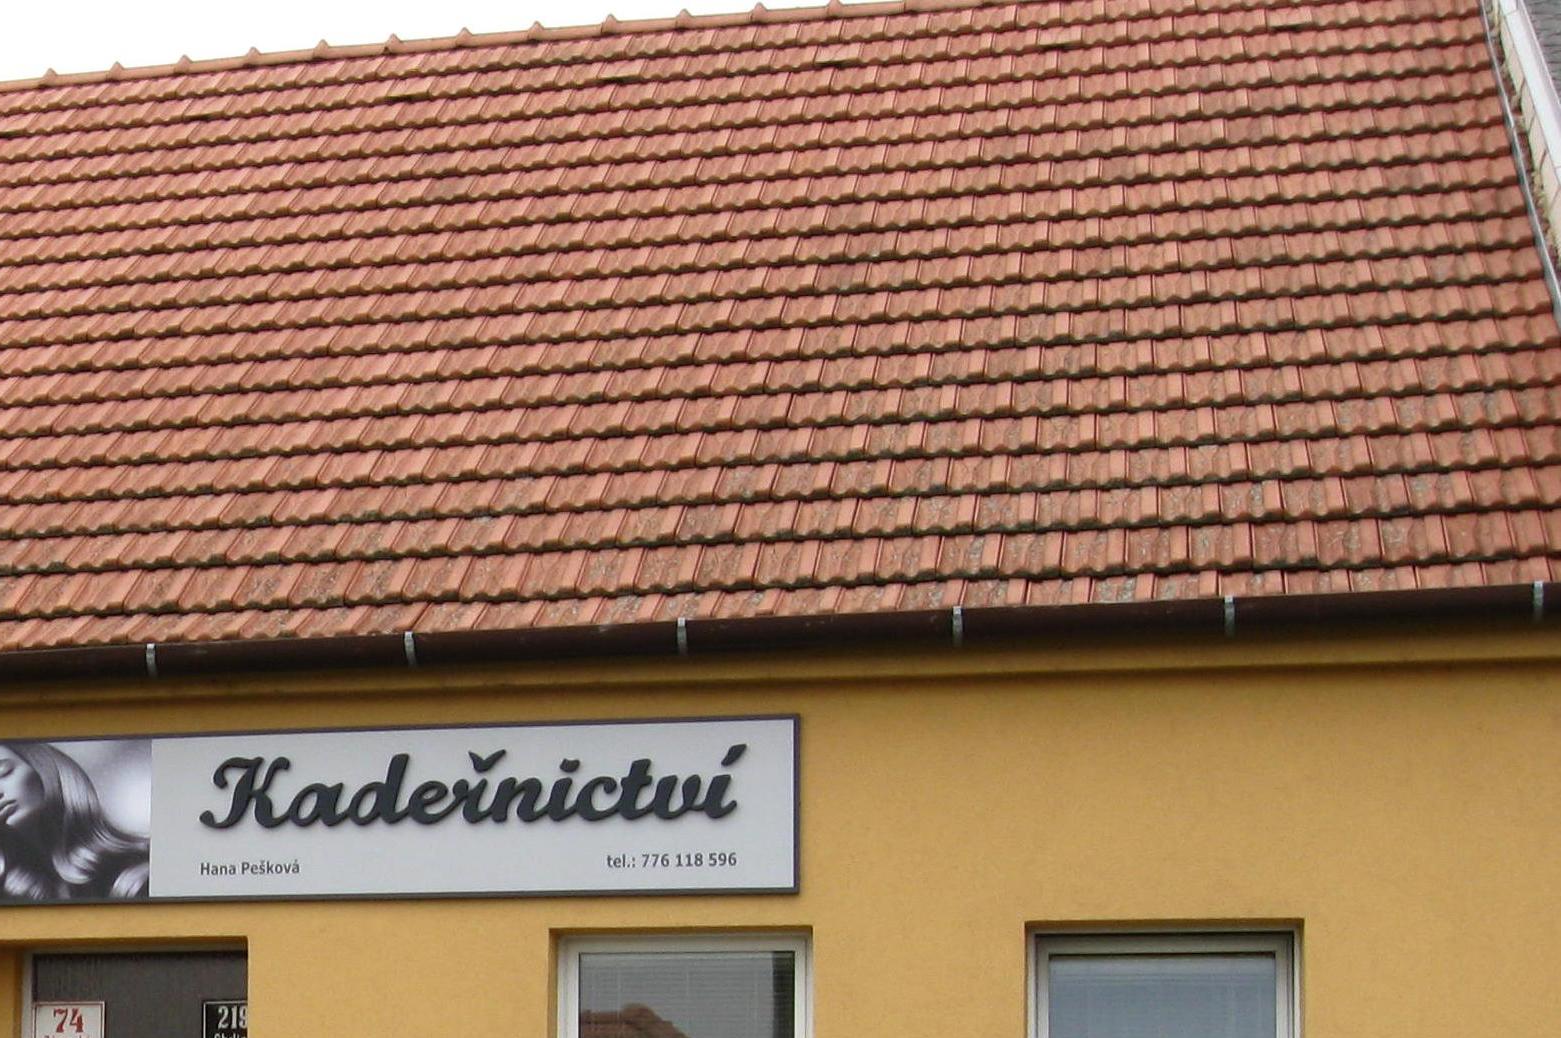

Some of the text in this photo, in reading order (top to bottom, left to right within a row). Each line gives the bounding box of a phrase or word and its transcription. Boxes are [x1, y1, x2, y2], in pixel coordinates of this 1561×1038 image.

[199, 744, 746, 829] Kadeřnictví
[200, 859, 300, 876] Hana Pešková
[606, 852, 737, 868] tel.: 776 118 596
[53, 1007, 83, 1033] 74
